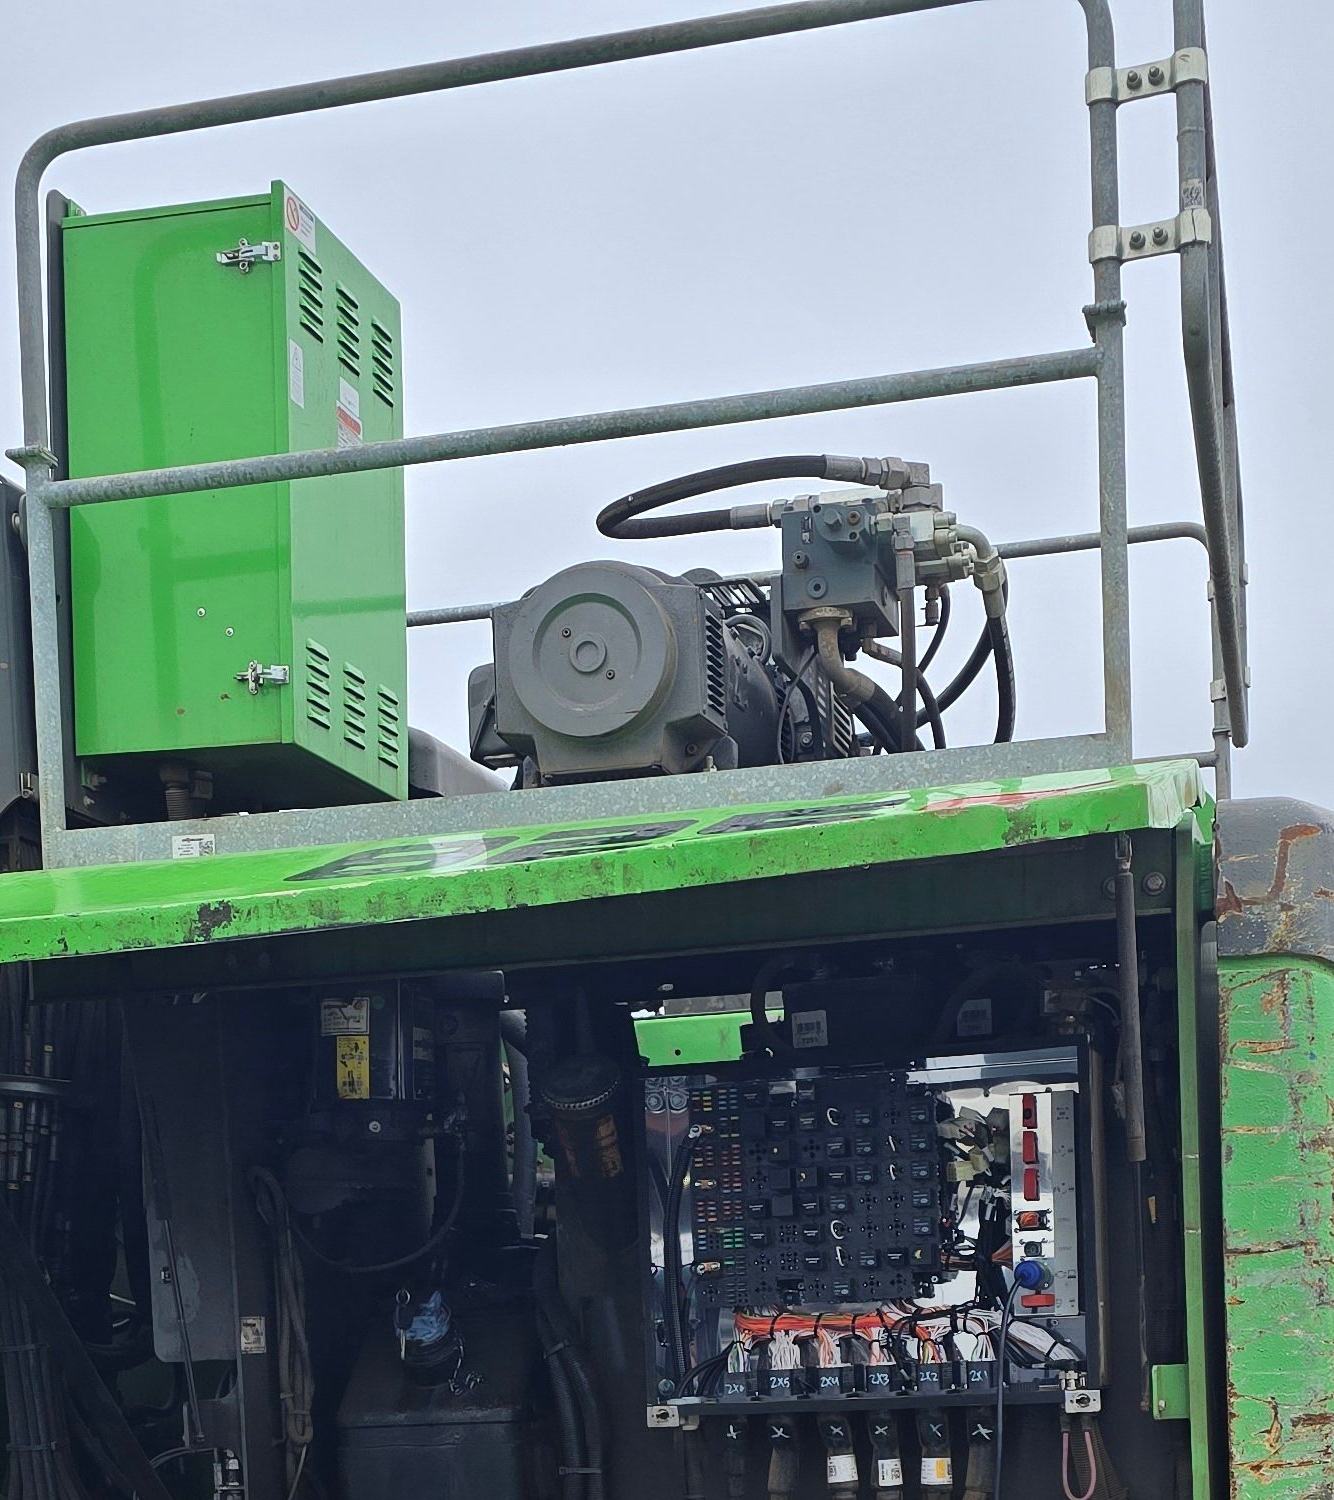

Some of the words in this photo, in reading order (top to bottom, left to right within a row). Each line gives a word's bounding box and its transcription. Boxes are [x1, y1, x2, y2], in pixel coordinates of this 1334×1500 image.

[820, 1376, 840, 1388] 2X4
[869, 1372, 890, 1385] 2X3
[919, 1371, 939, 1382] 2X2
[969, 1369, 988, 1382] 2X1
[770, 1376, 790, 1389] 2X5
